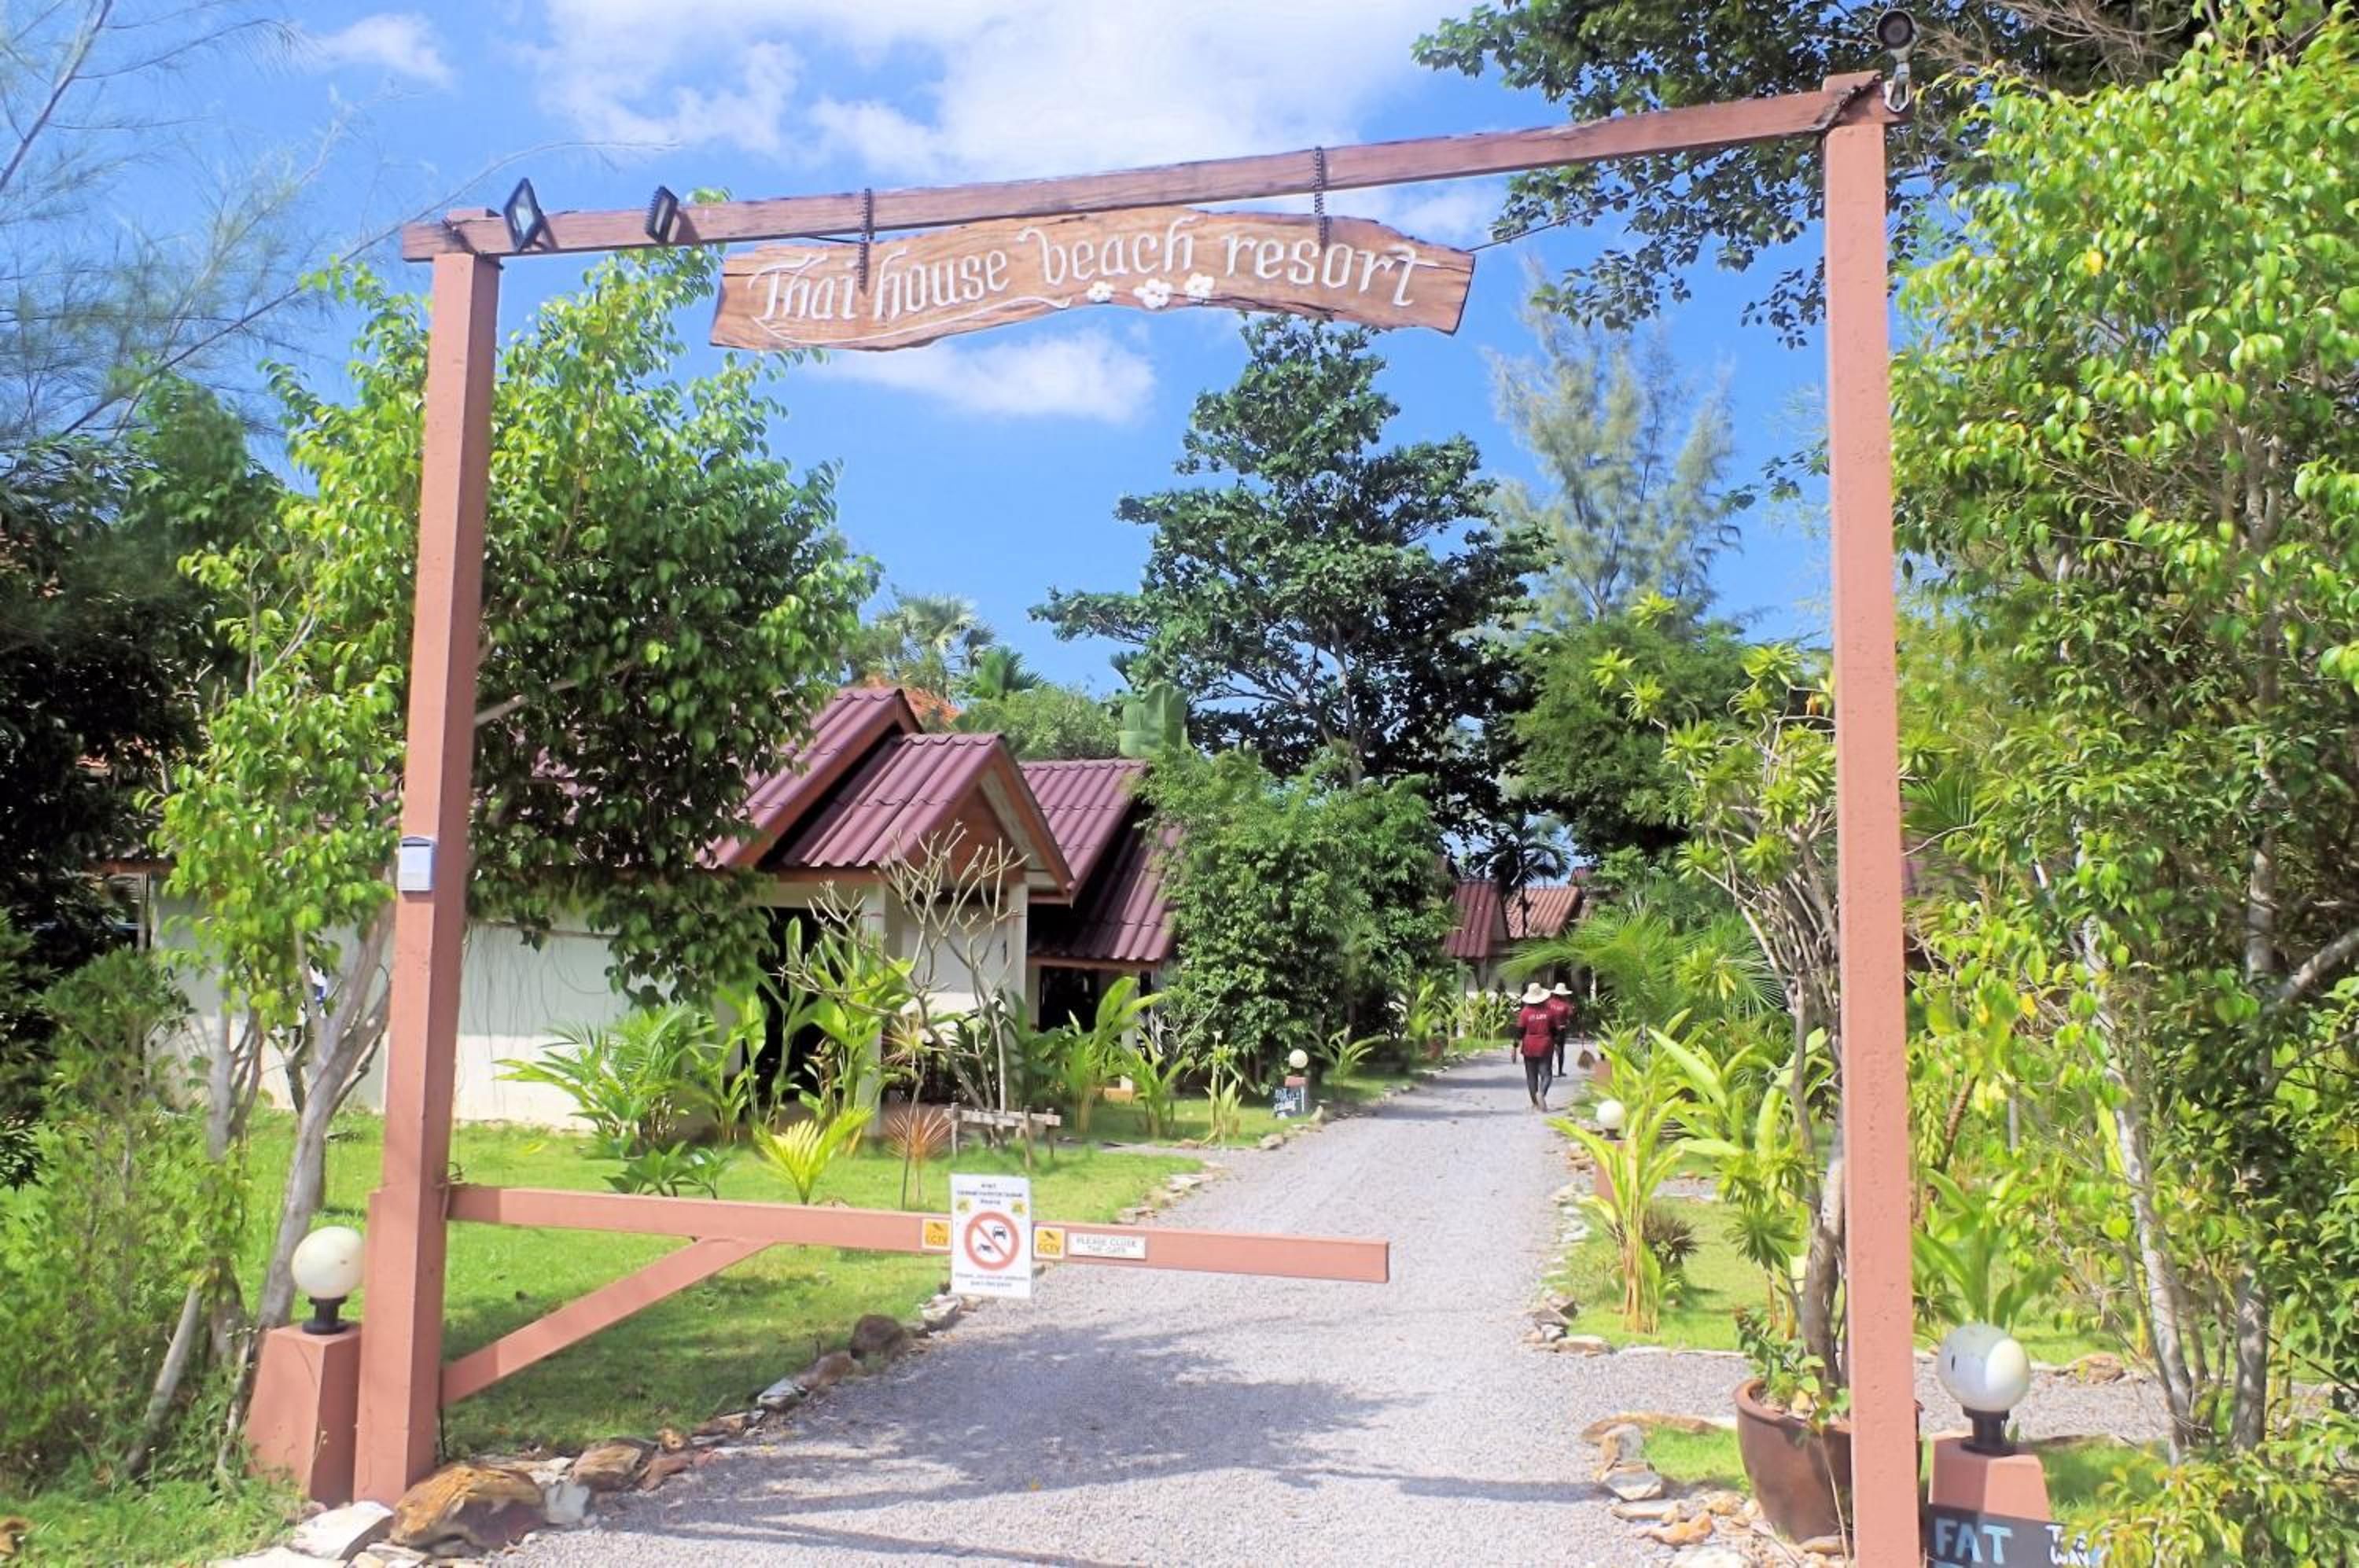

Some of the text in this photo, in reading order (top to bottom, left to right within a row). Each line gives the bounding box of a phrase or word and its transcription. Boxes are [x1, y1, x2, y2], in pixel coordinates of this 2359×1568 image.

[749, 214, 1442, 322] Thai house beach resort
[1036, 1244, 1060, 1257] CCTV
[1935, 1517, 2013, 1565] FAT
